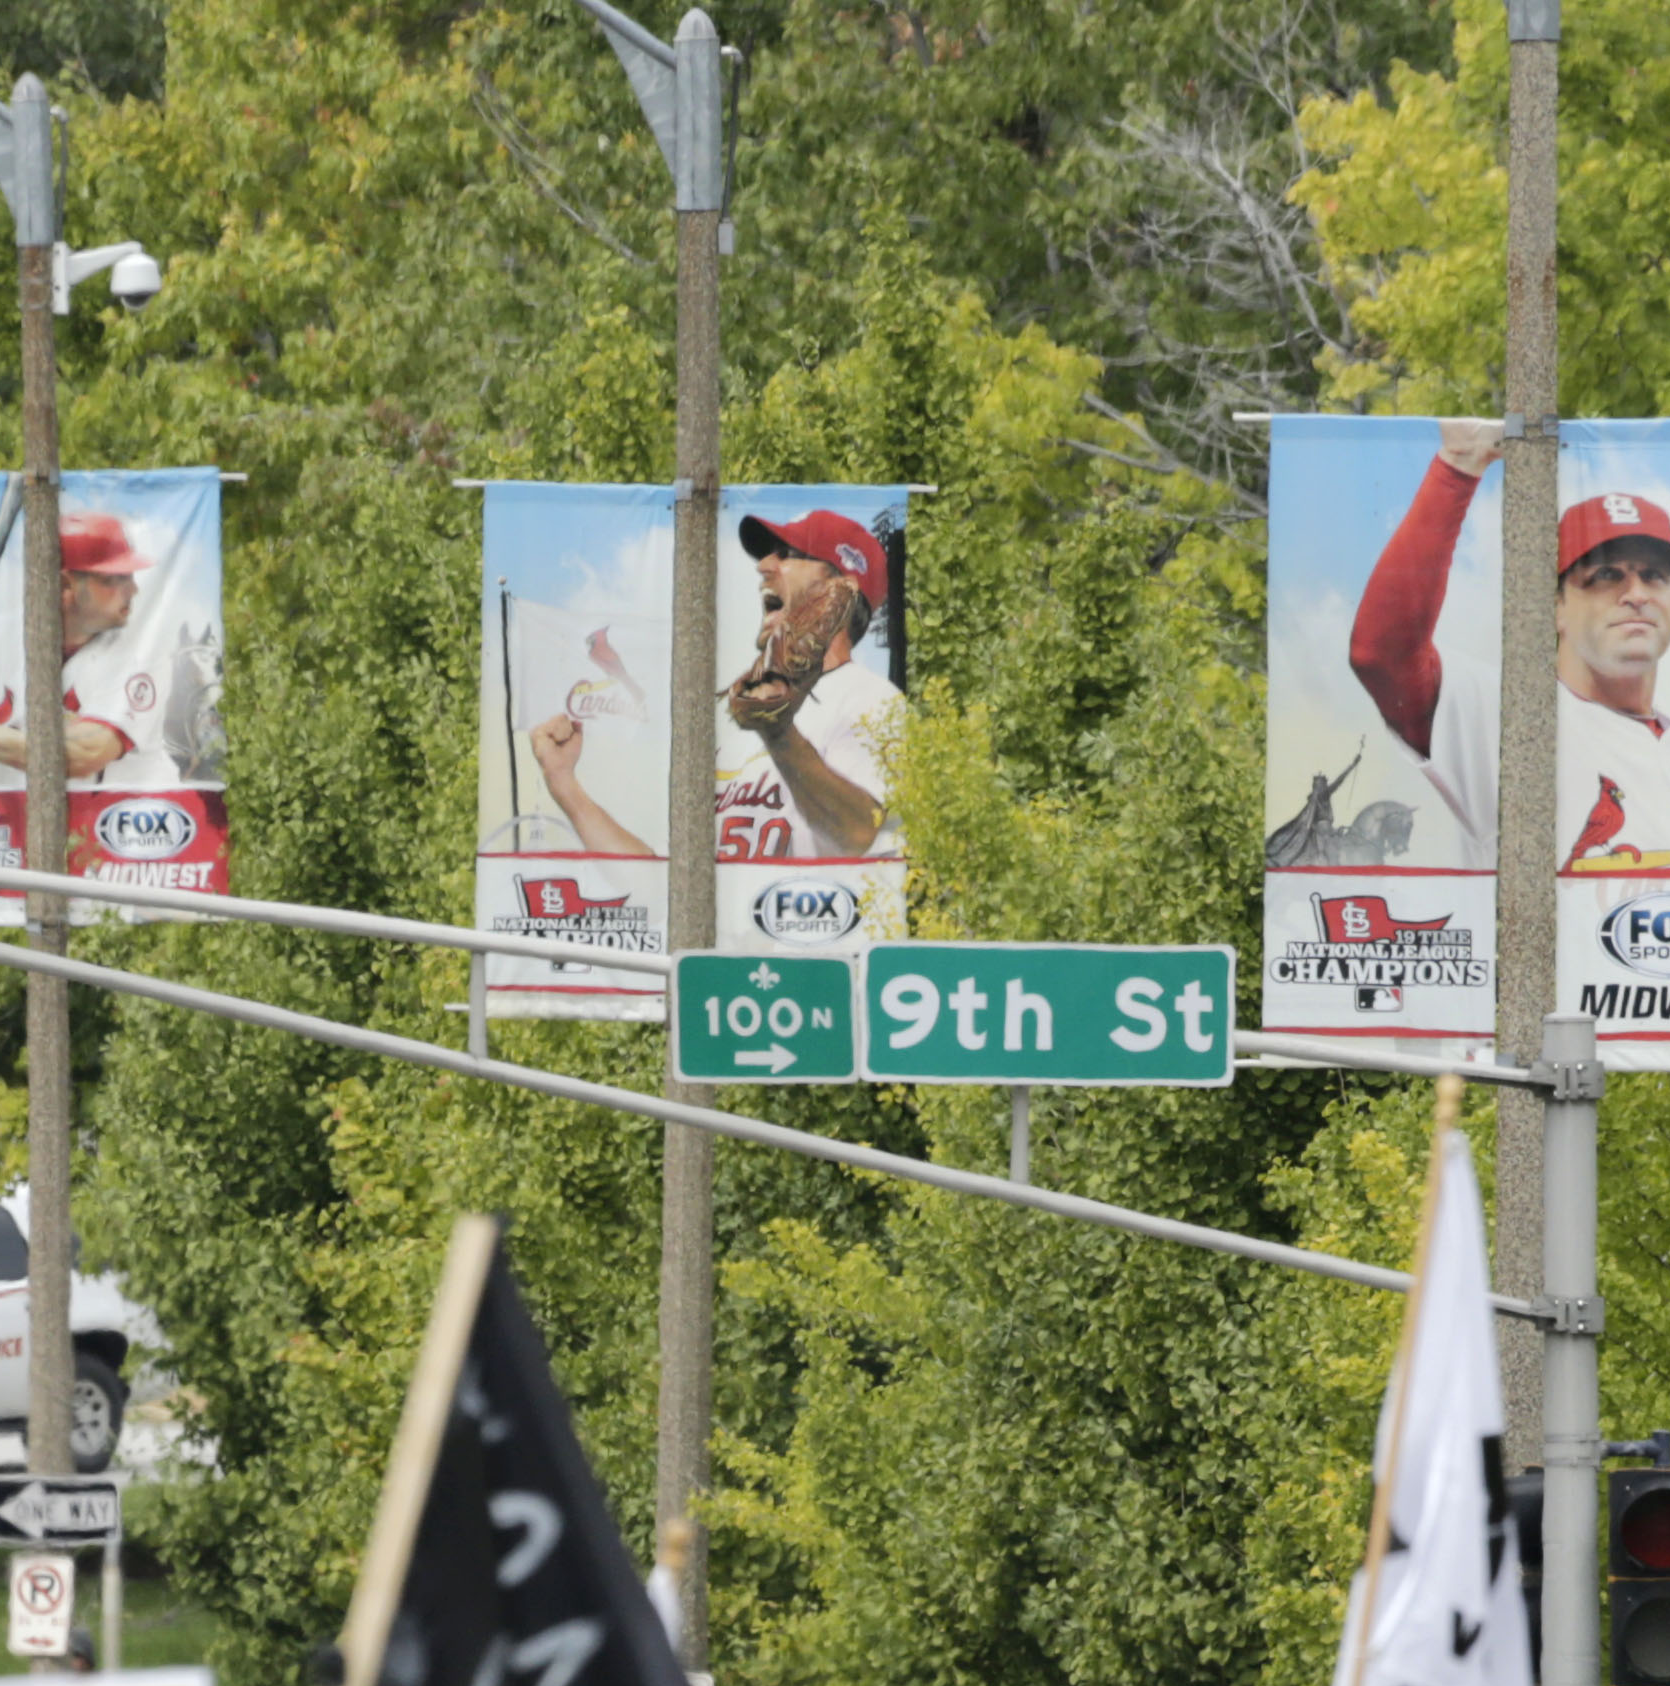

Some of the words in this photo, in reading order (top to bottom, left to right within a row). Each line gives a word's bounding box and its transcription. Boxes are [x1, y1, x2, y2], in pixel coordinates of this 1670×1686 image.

[117, 811, 172, 835] FOX
[717, 815, 792, 861] 50
[775, 890, 842, 919] FOX
[494, 916, 579, 932] NATIONAL
[579, 917, 648, 932] LEAGUE
[775, 919, 842, 933] SPORTS
[488, 931, 662, 953] AMPIONS
[1394, 929, 1416, 945] 19
[1417, 929, 1471, 945] TIME
[1286, 943, 1390, 959] NATIONAL
[1390, 945, 1471, 960] LEAGUE
[1269, 958, 1489, 987] CHAMPIONS
[704, 994, 804, 1038] 100
[880, 972, 1055, 1052] 9th
[1108, 976, 1217, 1055] St
[68, 1500, 110, 1524] WAY
